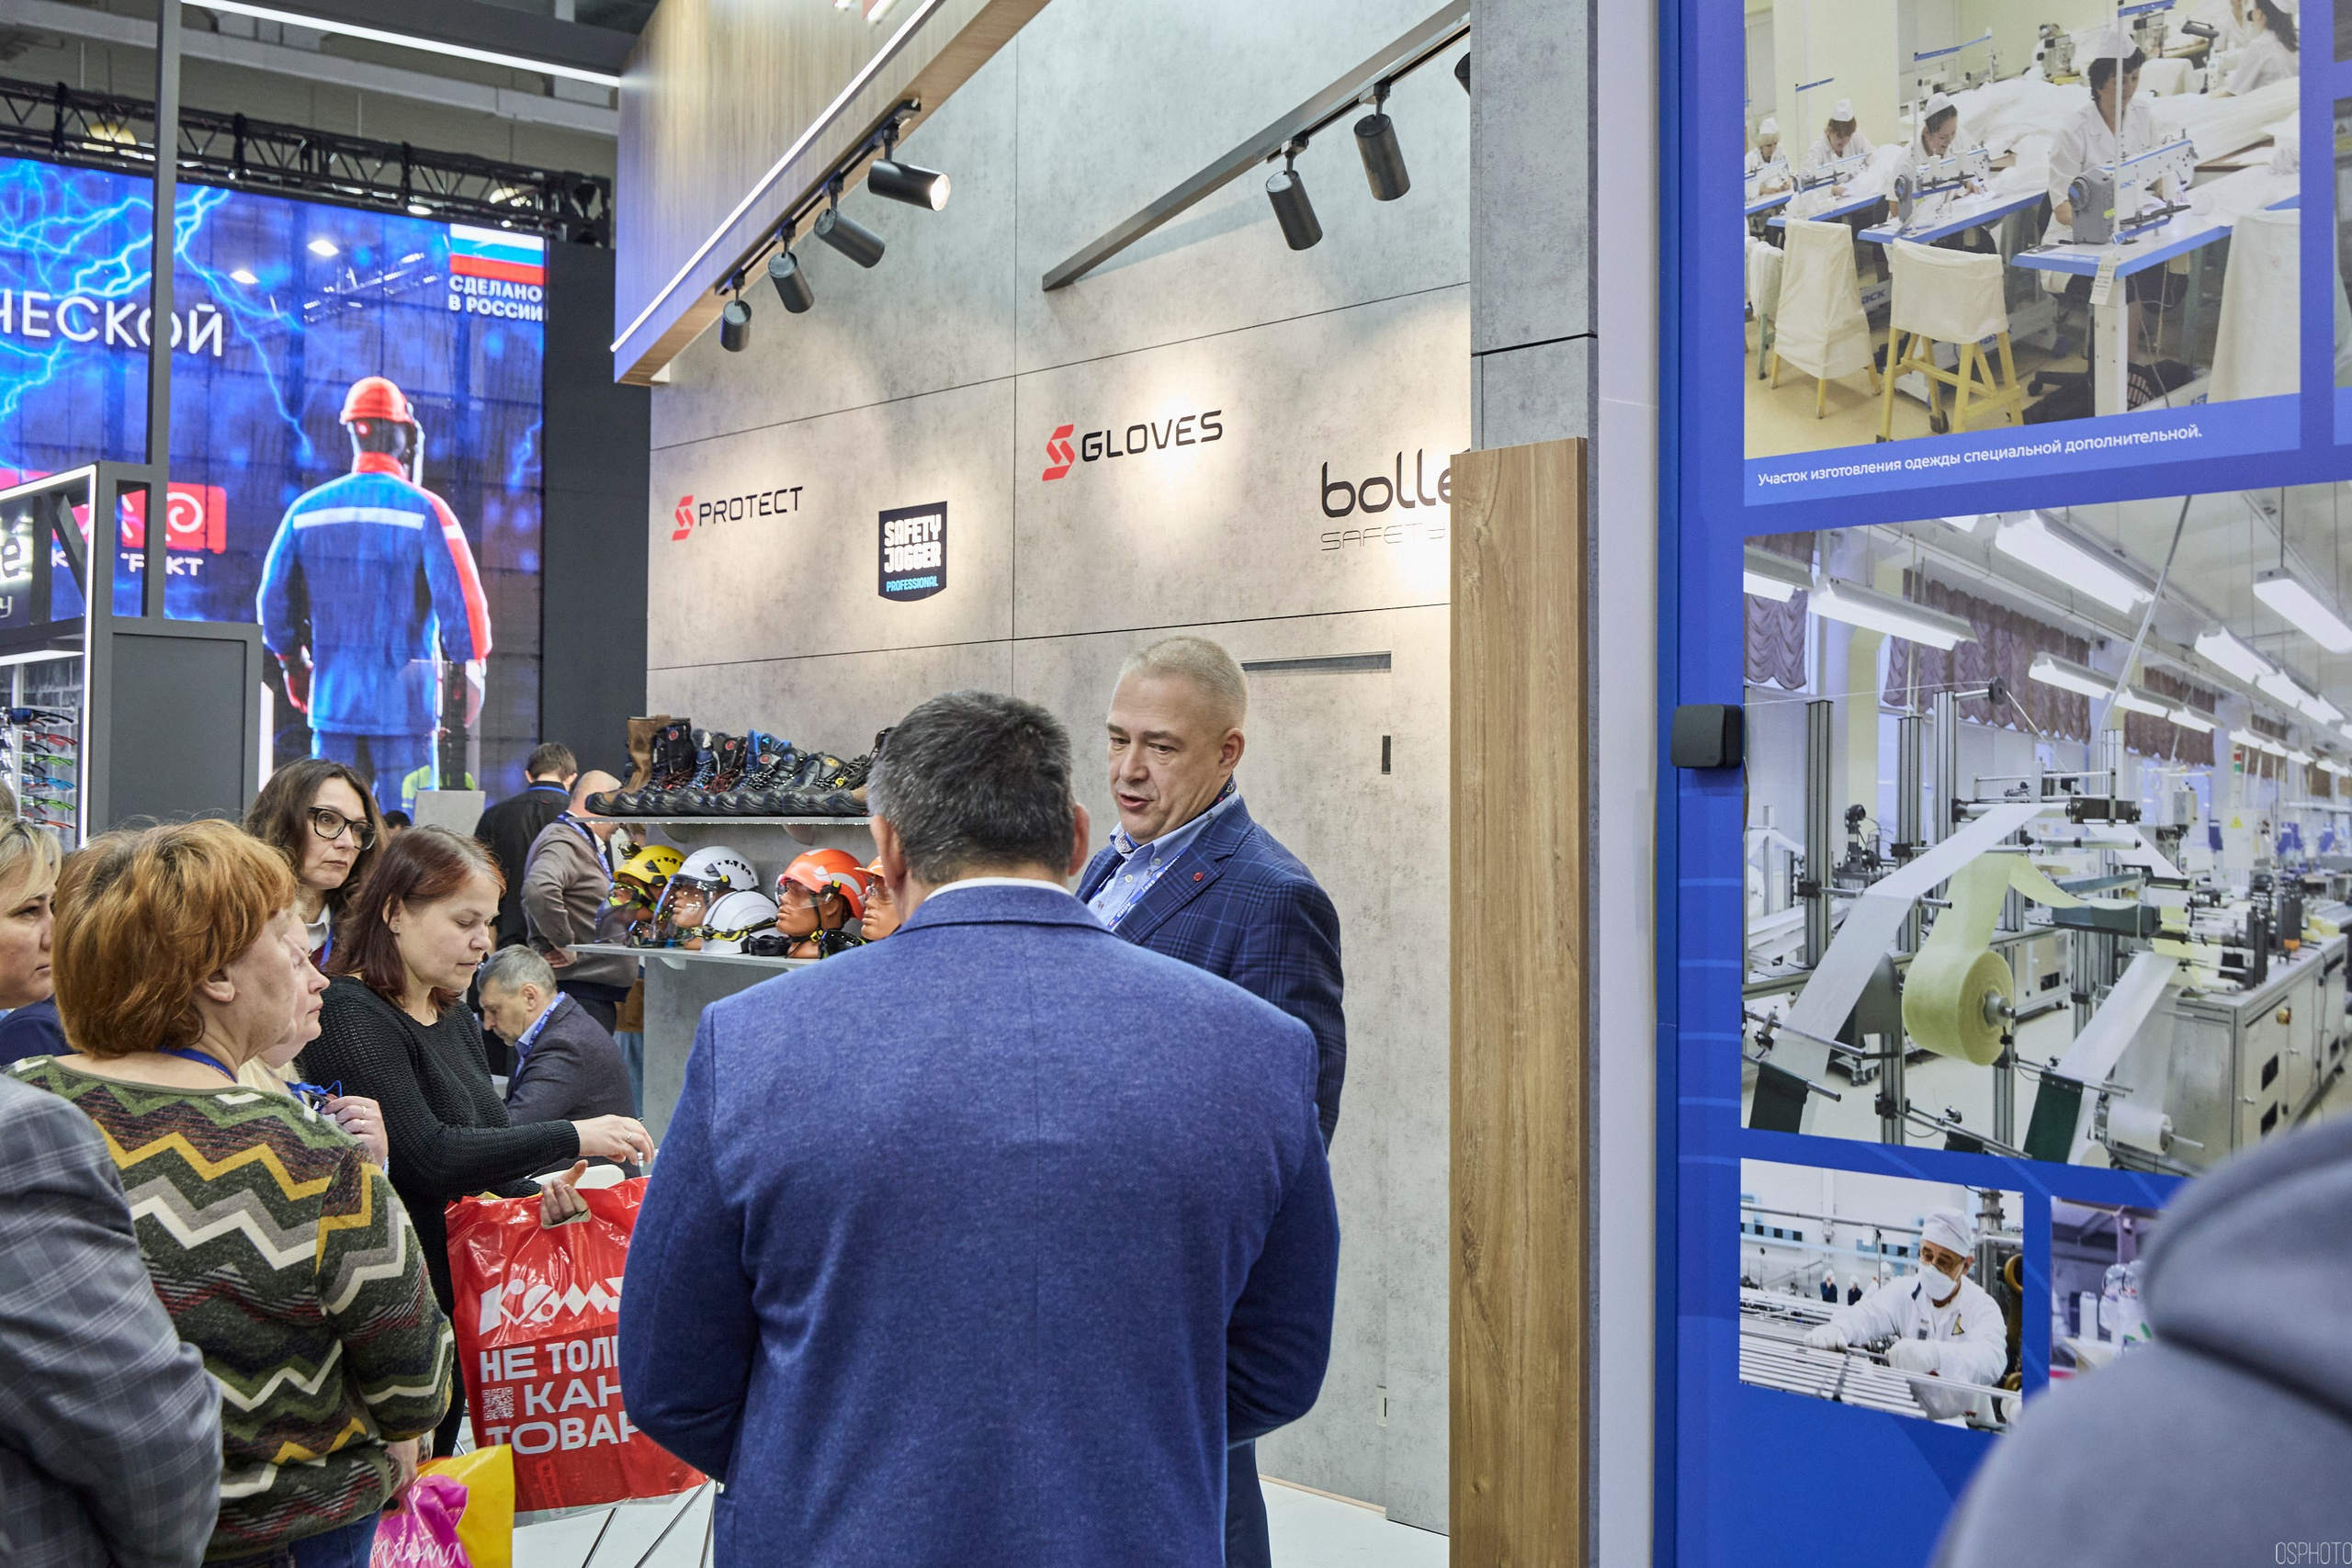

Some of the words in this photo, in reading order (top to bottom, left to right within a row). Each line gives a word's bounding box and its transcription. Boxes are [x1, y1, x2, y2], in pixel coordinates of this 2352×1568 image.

[448, 275, 543, 302] СДЕЛАНО
[448, 294, 461, 311] В
[466, 296, 543, 321] РОССИИ
[1081, 410, 1224, 462] GLOVES
[1758, 470, 1808, 487] Участок
[1811, 461, 1902, 481] изготовления
[1905, 454, 1961, 471] одежды
[1963, 439, 2063, 463] специальной
[2064, 423, 2203, 454] дополнительной.
[698, 486, 804, 526] PROTECT
[883, 513, 943, 547] SAFETY
[1320, 521, 1446, 551] SAFETY
[883, 540, 943, 573] JOGGER
[885, 575, 939, 592] PROFESSIONAL
[480, 1346, 538, 1383] НЕ
